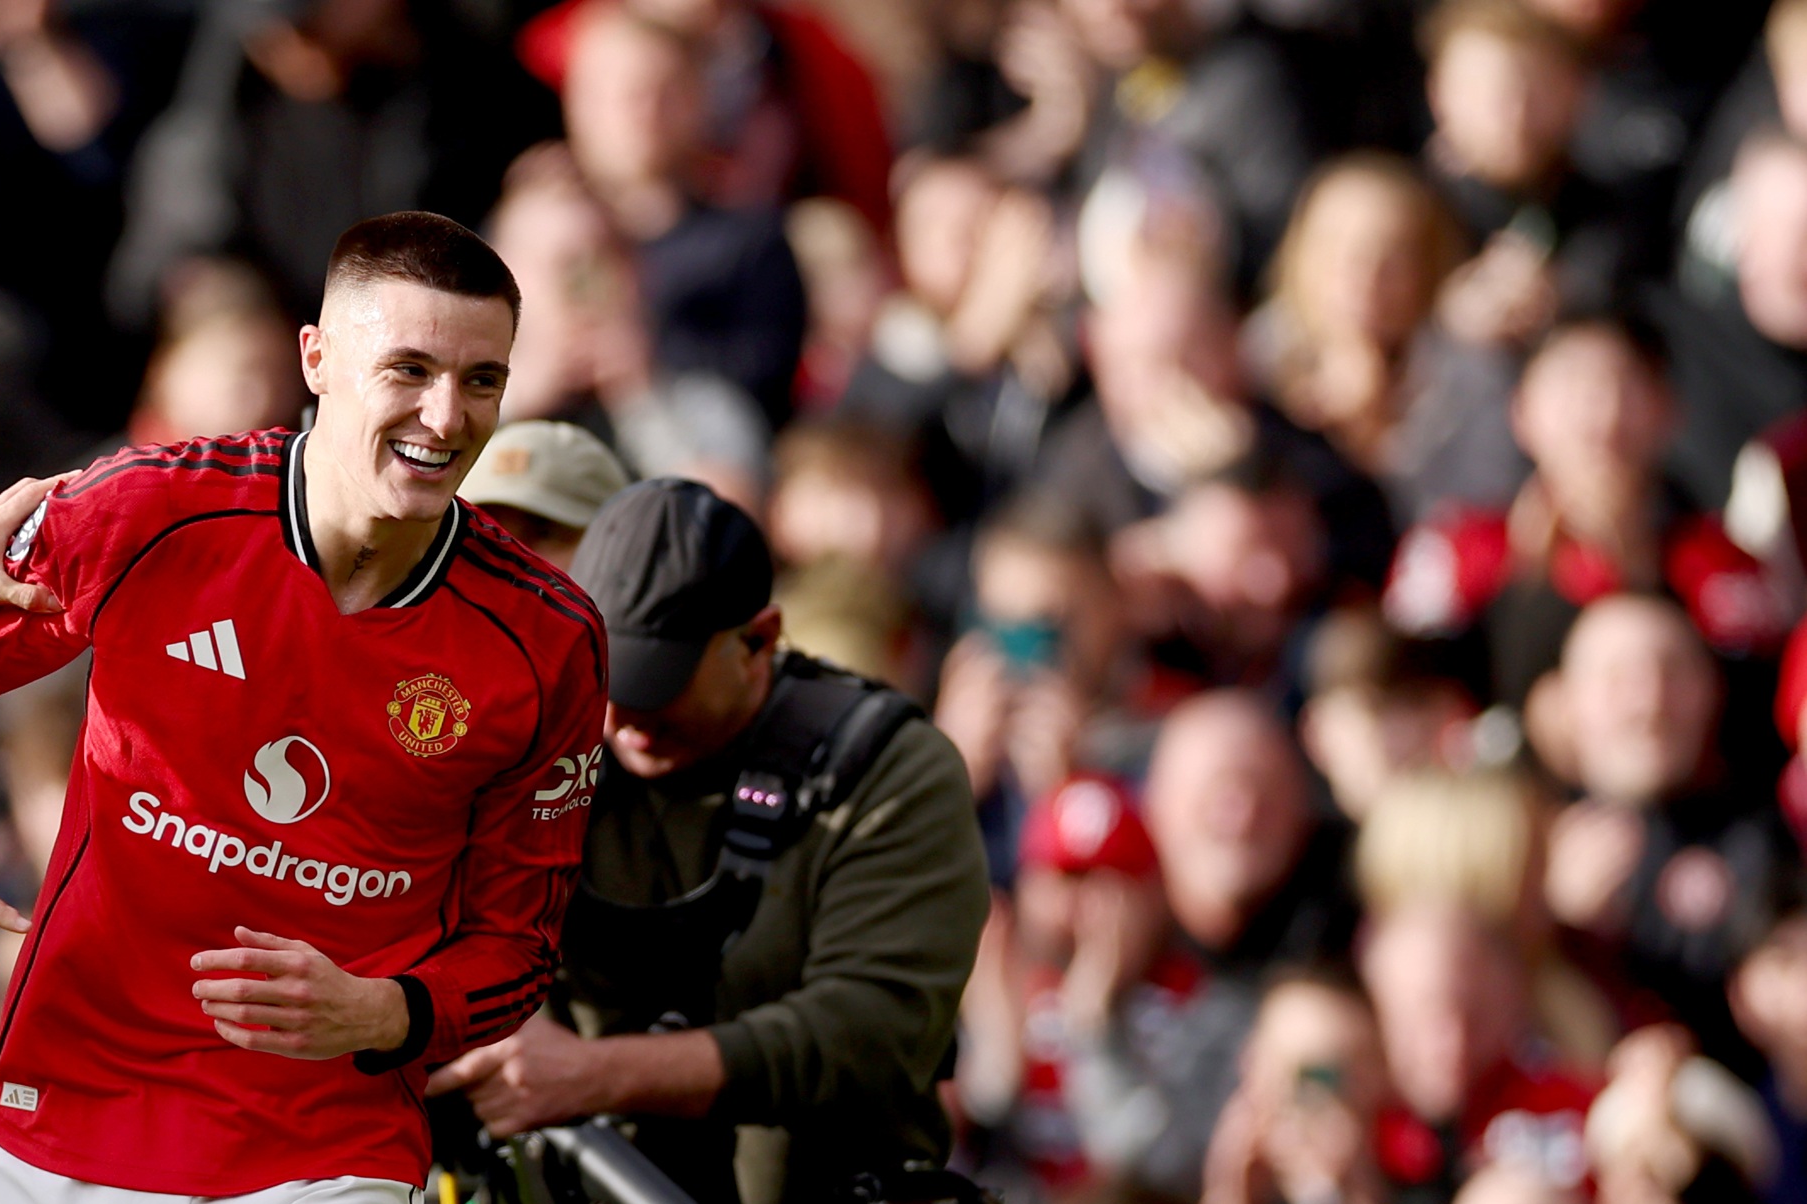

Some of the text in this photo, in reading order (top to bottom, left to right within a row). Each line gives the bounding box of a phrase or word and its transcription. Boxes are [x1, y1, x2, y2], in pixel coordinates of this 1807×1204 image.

[400, 679, 464, 716] MANCHESTER
[398, 731, 443, 752] UNITED
[121, 791, 412, 906] Snapdragon
